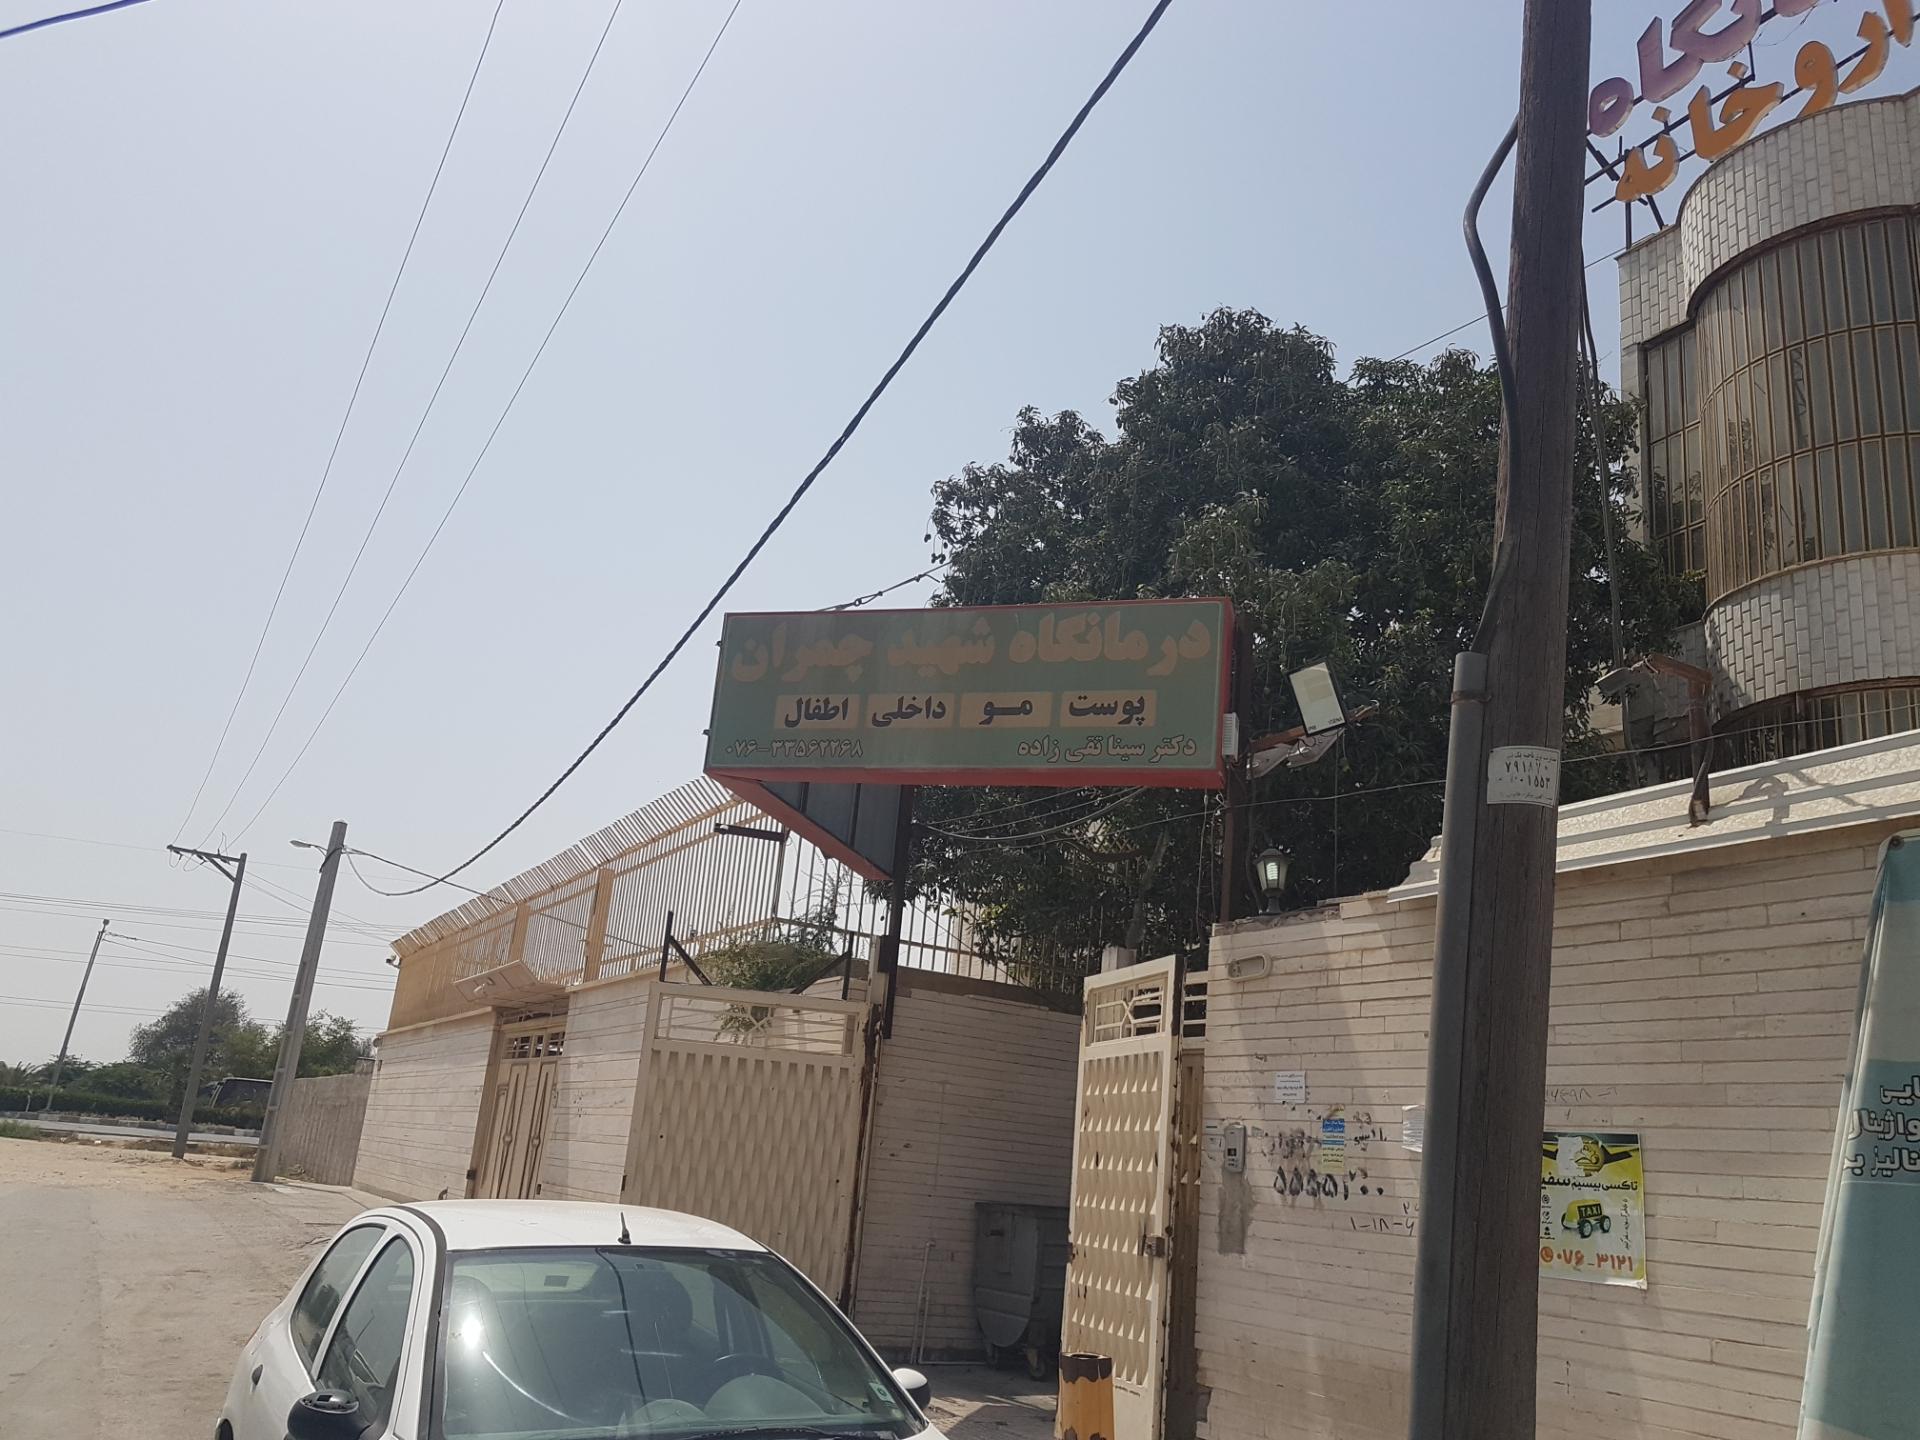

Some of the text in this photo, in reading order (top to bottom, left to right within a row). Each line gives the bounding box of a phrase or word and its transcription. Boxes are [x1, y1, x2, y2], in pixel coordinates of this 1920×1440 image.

[732, 611, 1211, 683] درمانگاه شهید چمران
[784, 695, 1146, 729] پوست مو داخلی اطفال
[1017, 735, 1197, 763] دکتر سینا تقی زاده
[1541, 1171, 1571, 1190] سفی
[1601, 1180, 1638, 1192] تاکسی
[1580, 1204, 1601, 1218] TAXI
